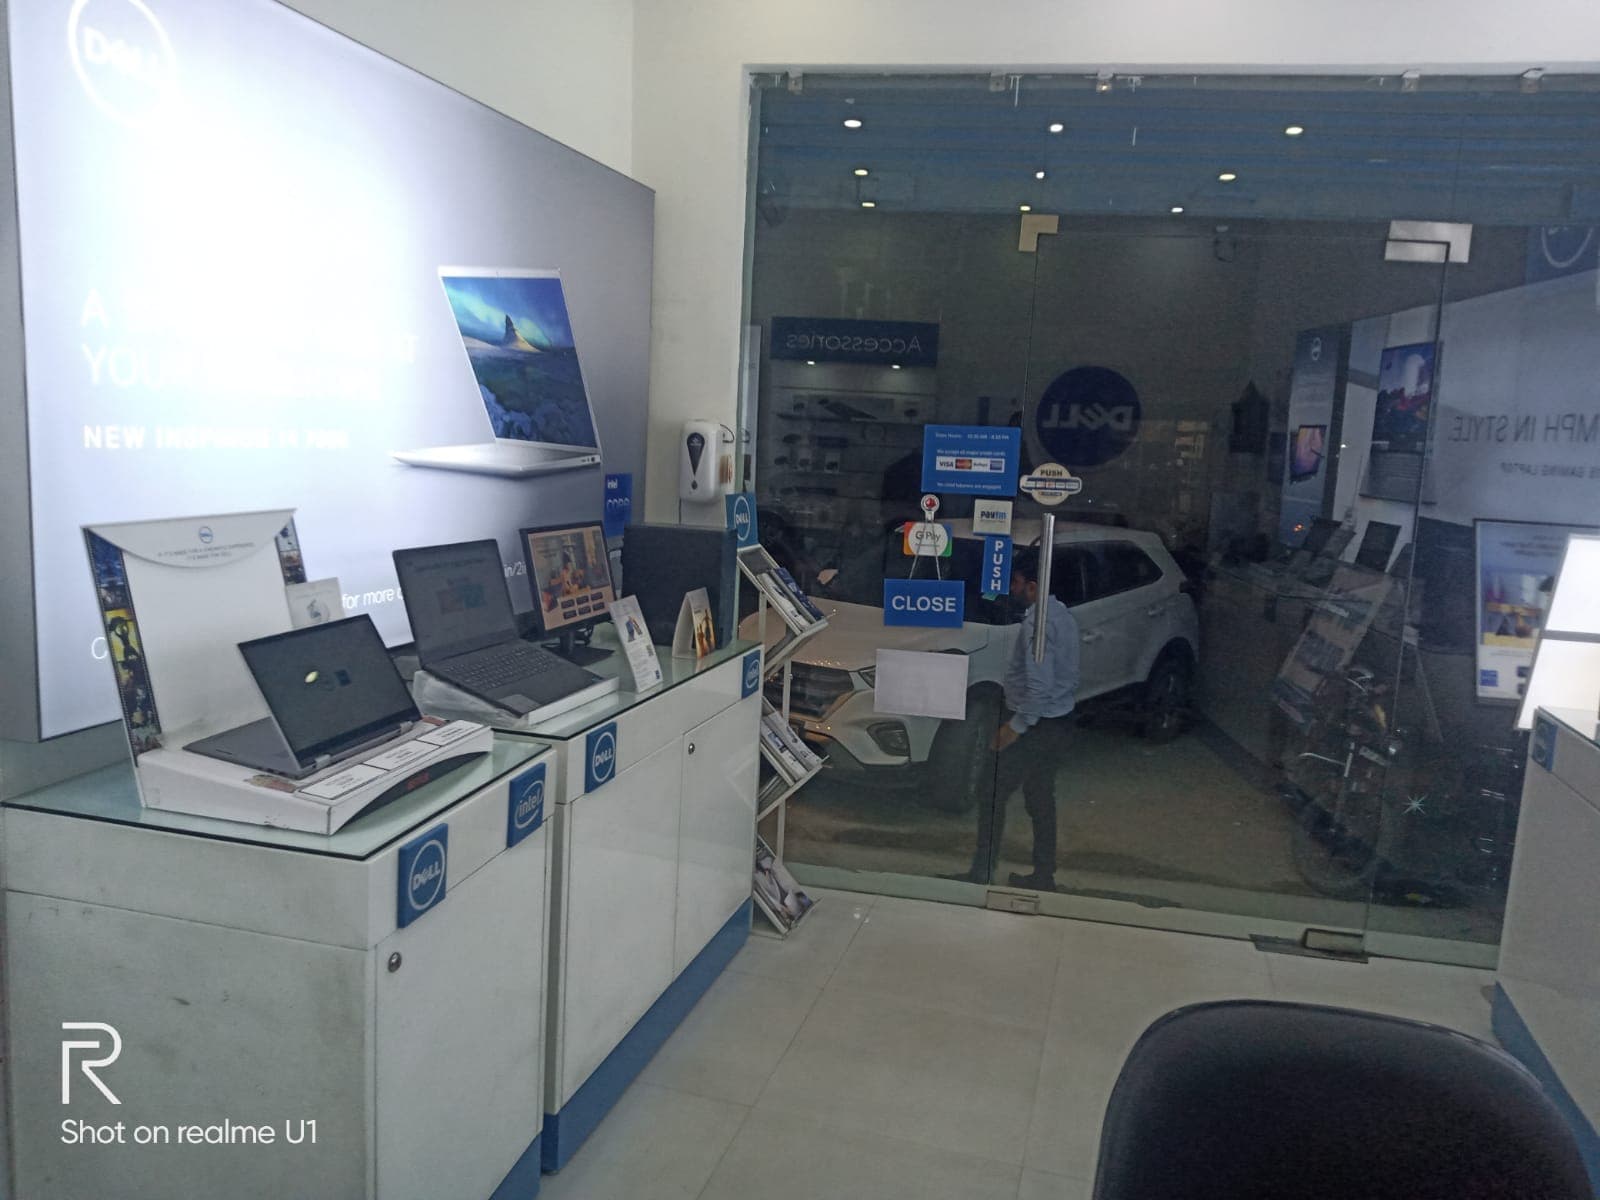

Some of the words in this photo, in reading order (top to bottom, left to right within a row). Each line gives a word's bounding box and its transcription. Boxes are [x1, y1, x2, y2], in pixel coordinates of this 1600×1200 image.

[83, 425, 146, 450] NEW
[939, 460, 954, 468] VISA
[1040, 469, 1063, 477] PUSH
[735, 512, 749, 525] DELL
[990, 540, 1005, 591] PUSH
[342, 593, 360, 609] for
[363, 588, 395, 607] more
[892, 595, 957, 613] CLOSE
[594, 747, 613, 766] DELL
[518, 792, 544, 817] intel
[412, 862, 441, 892] DELL
